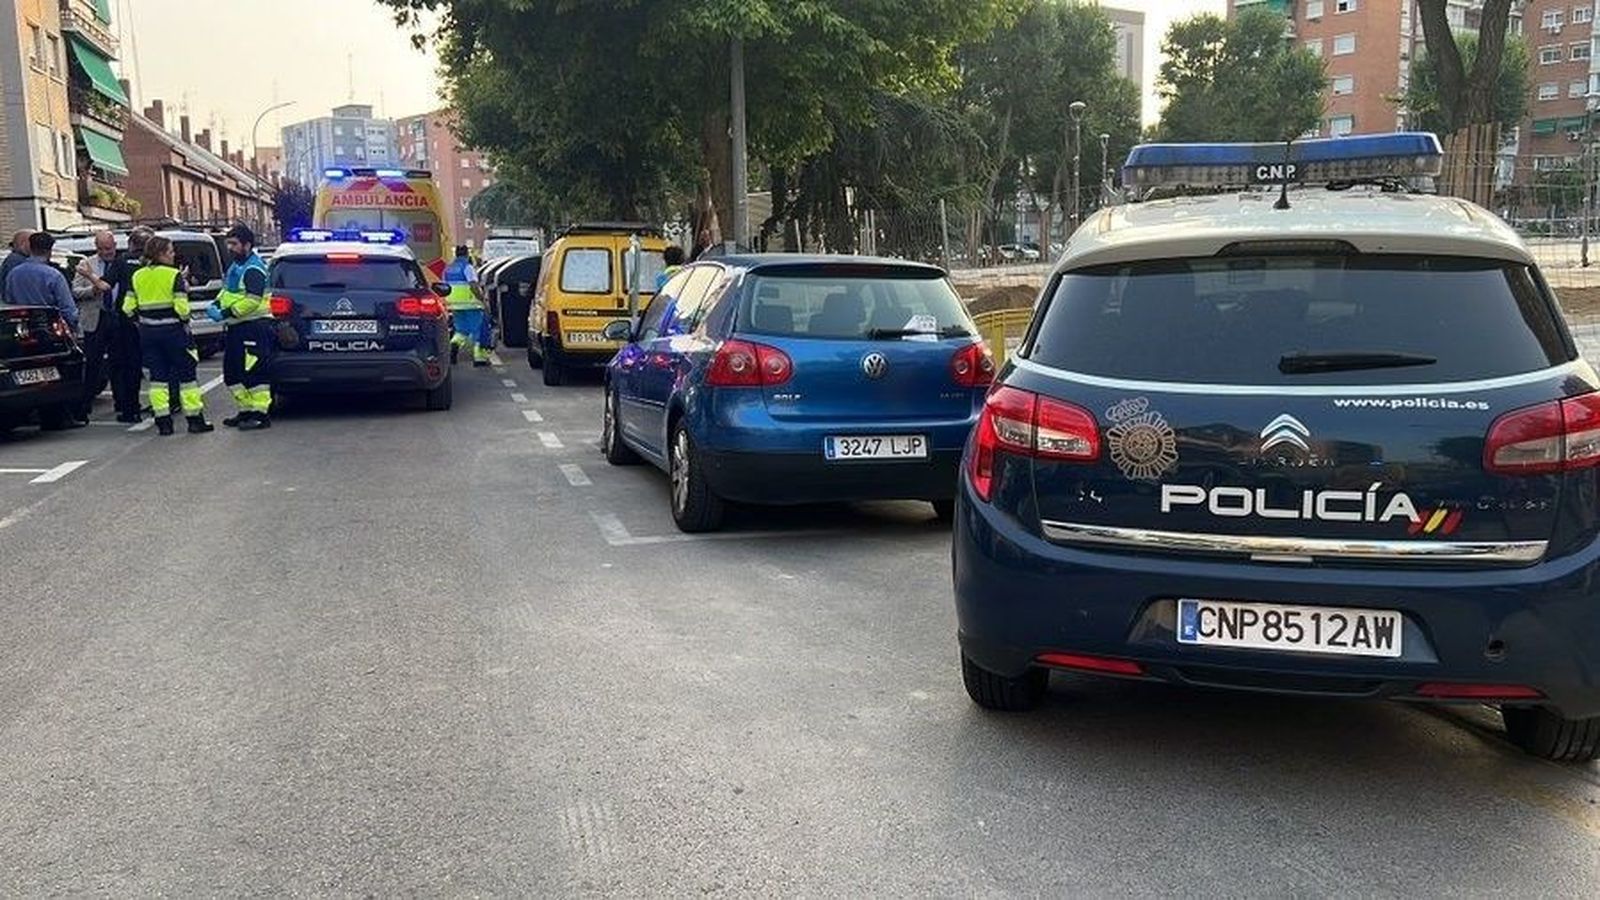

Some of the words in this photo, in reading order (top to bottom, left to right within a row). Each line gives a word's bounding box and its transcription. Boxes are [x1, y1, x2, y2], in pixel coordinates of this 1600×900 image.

[331, 194, 429, 207] AMBULANCIA
[840, 438, 882, 456] 3247
[890, 437, 922, 455] LJP
[1160, 481, 1420, 523] POLICÍA
[1197, 606, 1395, 650] CNP8512AW
